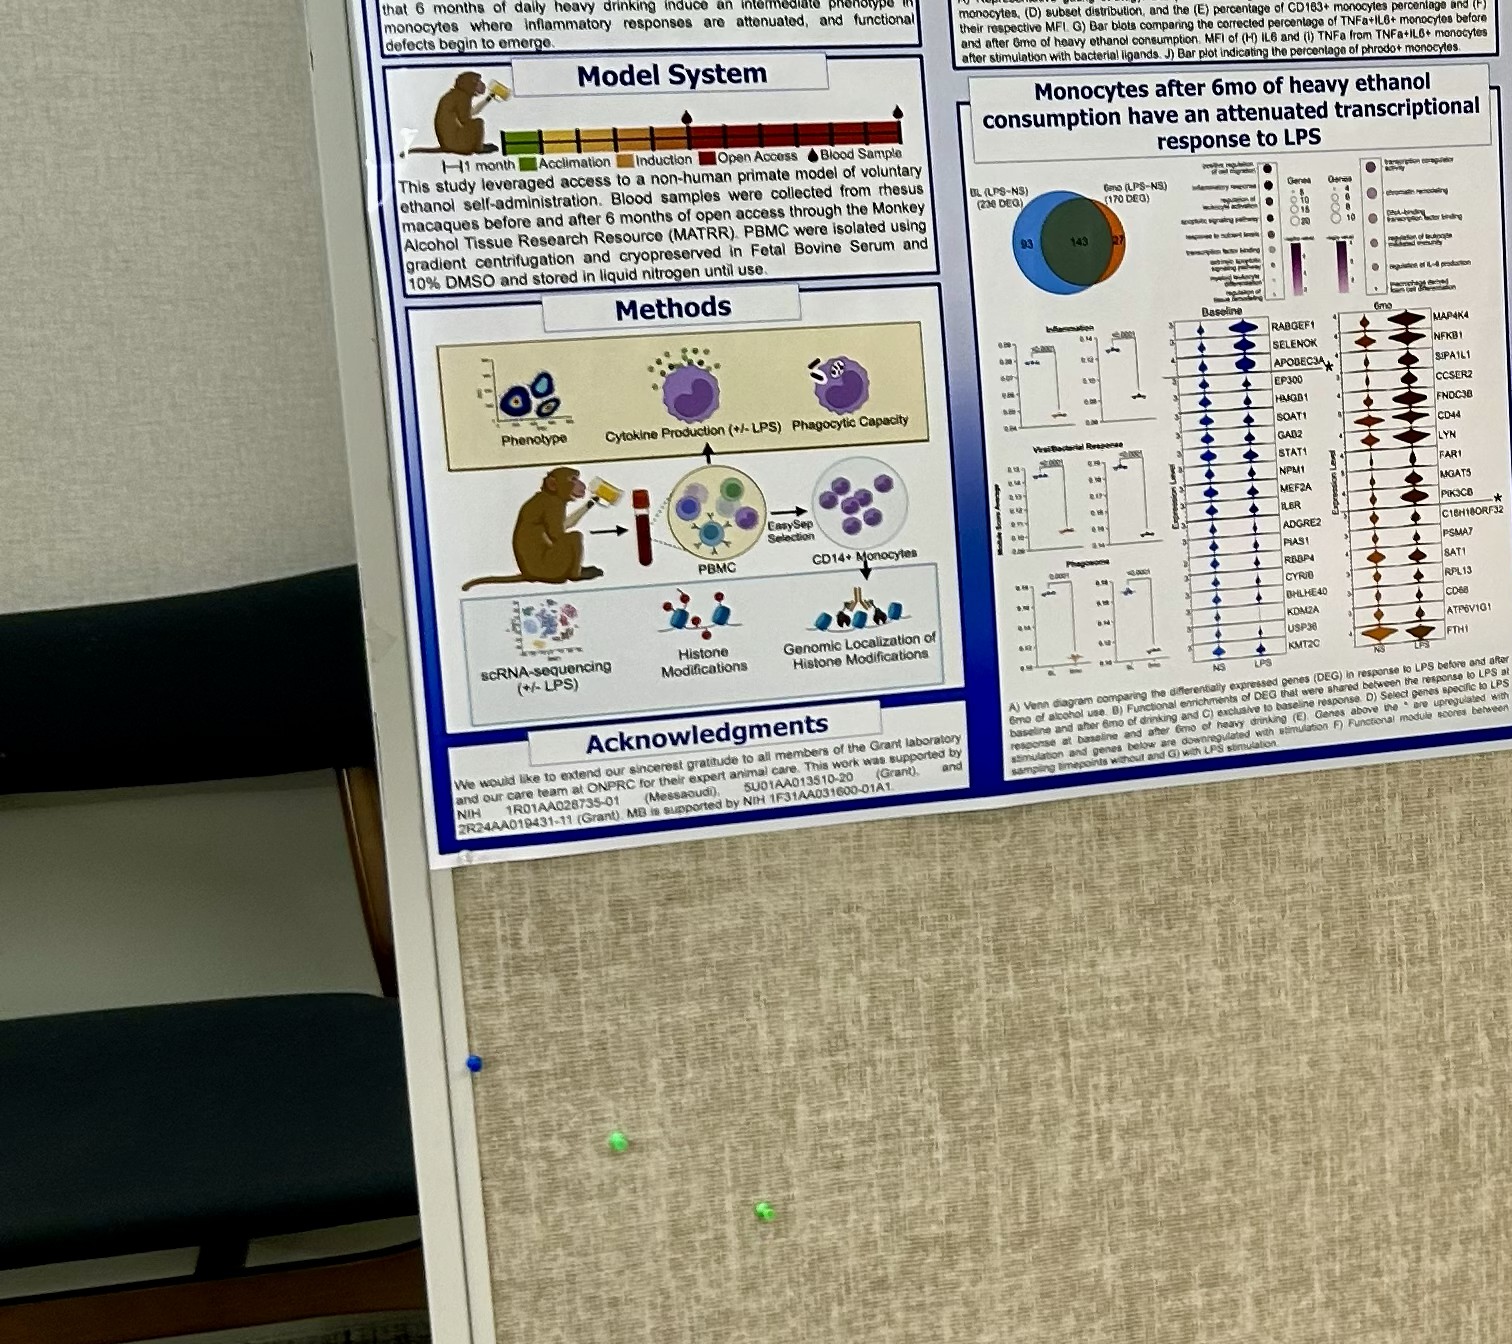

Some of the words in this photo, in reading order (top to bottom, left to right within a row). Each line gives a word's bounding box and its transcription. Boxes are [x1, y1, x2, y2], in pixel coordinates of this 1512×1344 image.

[385, 37, 436, 55] defects
[438, 37, 478, 55] begin
[481, 37, 496, 54] to
[498, 37, 555, 54] emerge.
[577, 62, 660, 87] Model
[668, 63, 768, 90] System
[1034, 81, 1150, 104] Monocytes
[1155, 78, 1207, 98] after
[1211, 78, 1258, 97] 6mo
[1262, 75, 1285, 95] of
[1289, 75, 1350, 97] heavy
[1355, 71, 1431, 93] ethanol
[982, 107, 1122, 132] consumption
[1127, 106, 1179, 125] have
[1184, 108, 1210, 124] an
[1216, 100, 1329, 123] attenuated
[1334, 96, 1480, 119] transcriptional
[1157, 133, 1251, 154] response
[1256, 129, 1278, 147] to
[1284, 127, 1322, 146] LPS
[538, 152, 612, 170] Acclimation
[635, 150, 693, 167] Induction
[717, 151, 752, 166] Open
[753, 145, 799, 163] Access
[819, 145, 855, 161] Blood
[857, 142, 903, 161] Sample
[409, 276, 441, 291] 10%
[445, 273, 496, 290] DMSO
[500, 272, 528, 287] and
[532, 269, 578, 286] stored
[582, 270, 596, 283] in
[599, 267, 638, 287] liquid
[641, 267, 701, 286] nitrogen
[704, 263, 734, 283] until
[737, 264, 767, 282] use.
[615, 294, 732, 322] Methods
[1274, 374, 1304, 386] EP300
[791, 413, 857, 433] Phagocytic
[858, 414, 909, 429] Capacity
[1437, 409, 1461, 421] CD44
[501, 429, 568, 447] Phenotype
[605, 429, 659, 445] Cytokine
[661, 421, 726, 439] Production
[751, 420, 782, 435] LPS)
[767, 532, 815, 544] Selection
[698, 558, 737, 575] PBMC
[812, 552, 852, 566] CD14+
[855, 549, 918, 561] Monocytes
[783, 640, 842, 656] Genomic
[844, 634, 921, 653] Localization
[923, 630, 936, 644] of
[678, 647, 729, 661] Histone
[793, 653, 843, 670] Histone
[845, 649, 929, 666] Modifications
[480, 661, 612, 684] scRNA-sequencing
[661, 661, 748, 679] Modifications
[585, 715, 829, 755] Acknowledgments
